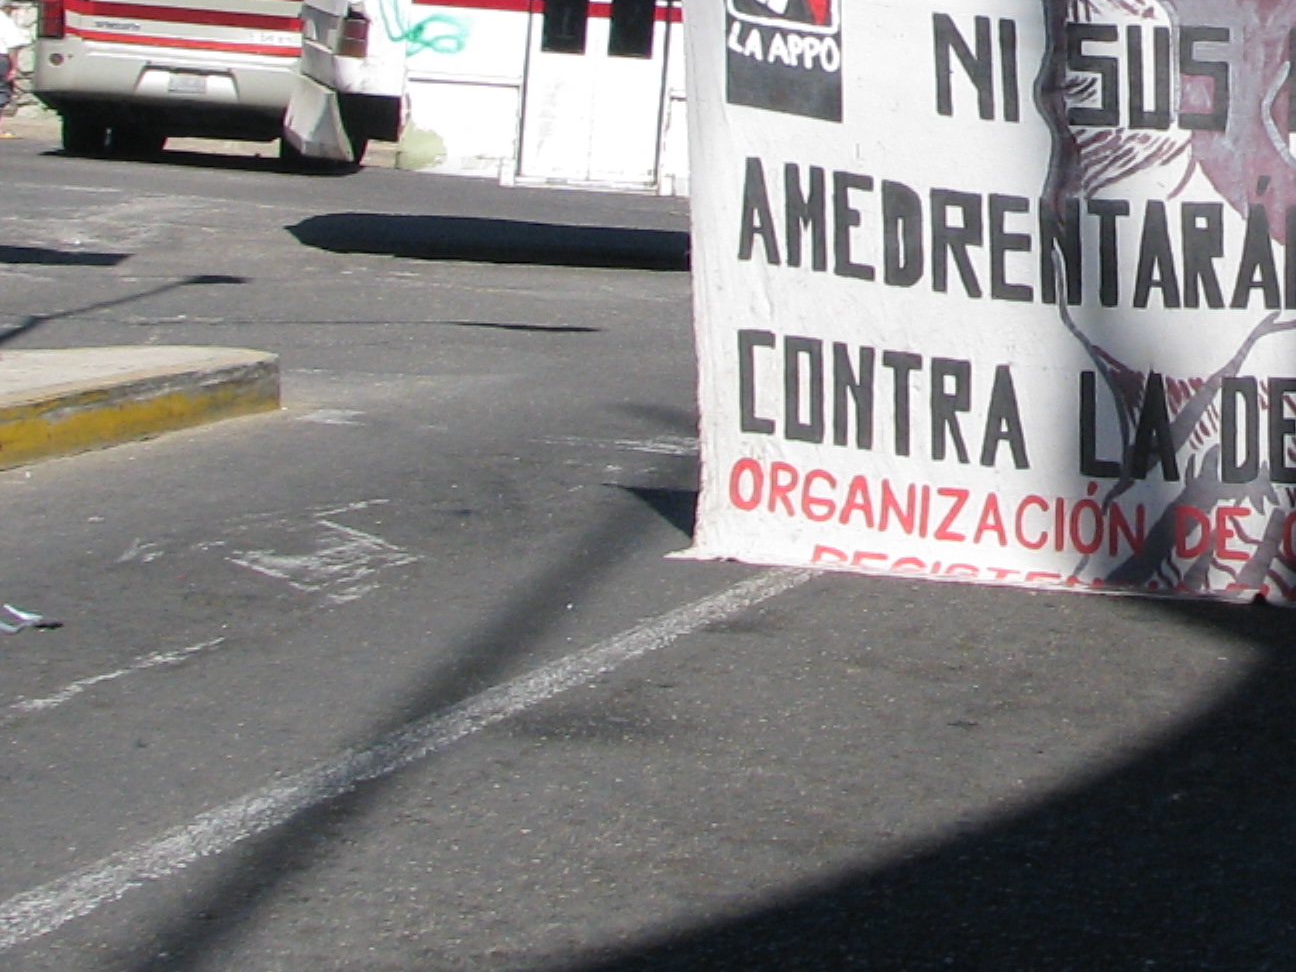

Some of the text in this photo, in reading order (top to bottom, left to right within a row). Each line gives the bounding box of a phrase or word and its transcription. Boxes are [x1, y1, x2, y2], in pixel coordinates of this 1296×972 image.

[728, 21, 840, 73] LA APPO
[931, 12, 1020, 122] NI
[1066, 20, 1230, 133] SUS
[737, 328, 1031, 469] CONTRA
[1080, 370, 1181, 482] LA
[729, 457, 1145, 559] ORGANIZACIÓN
[1175, 505, 1250, 561] DE
